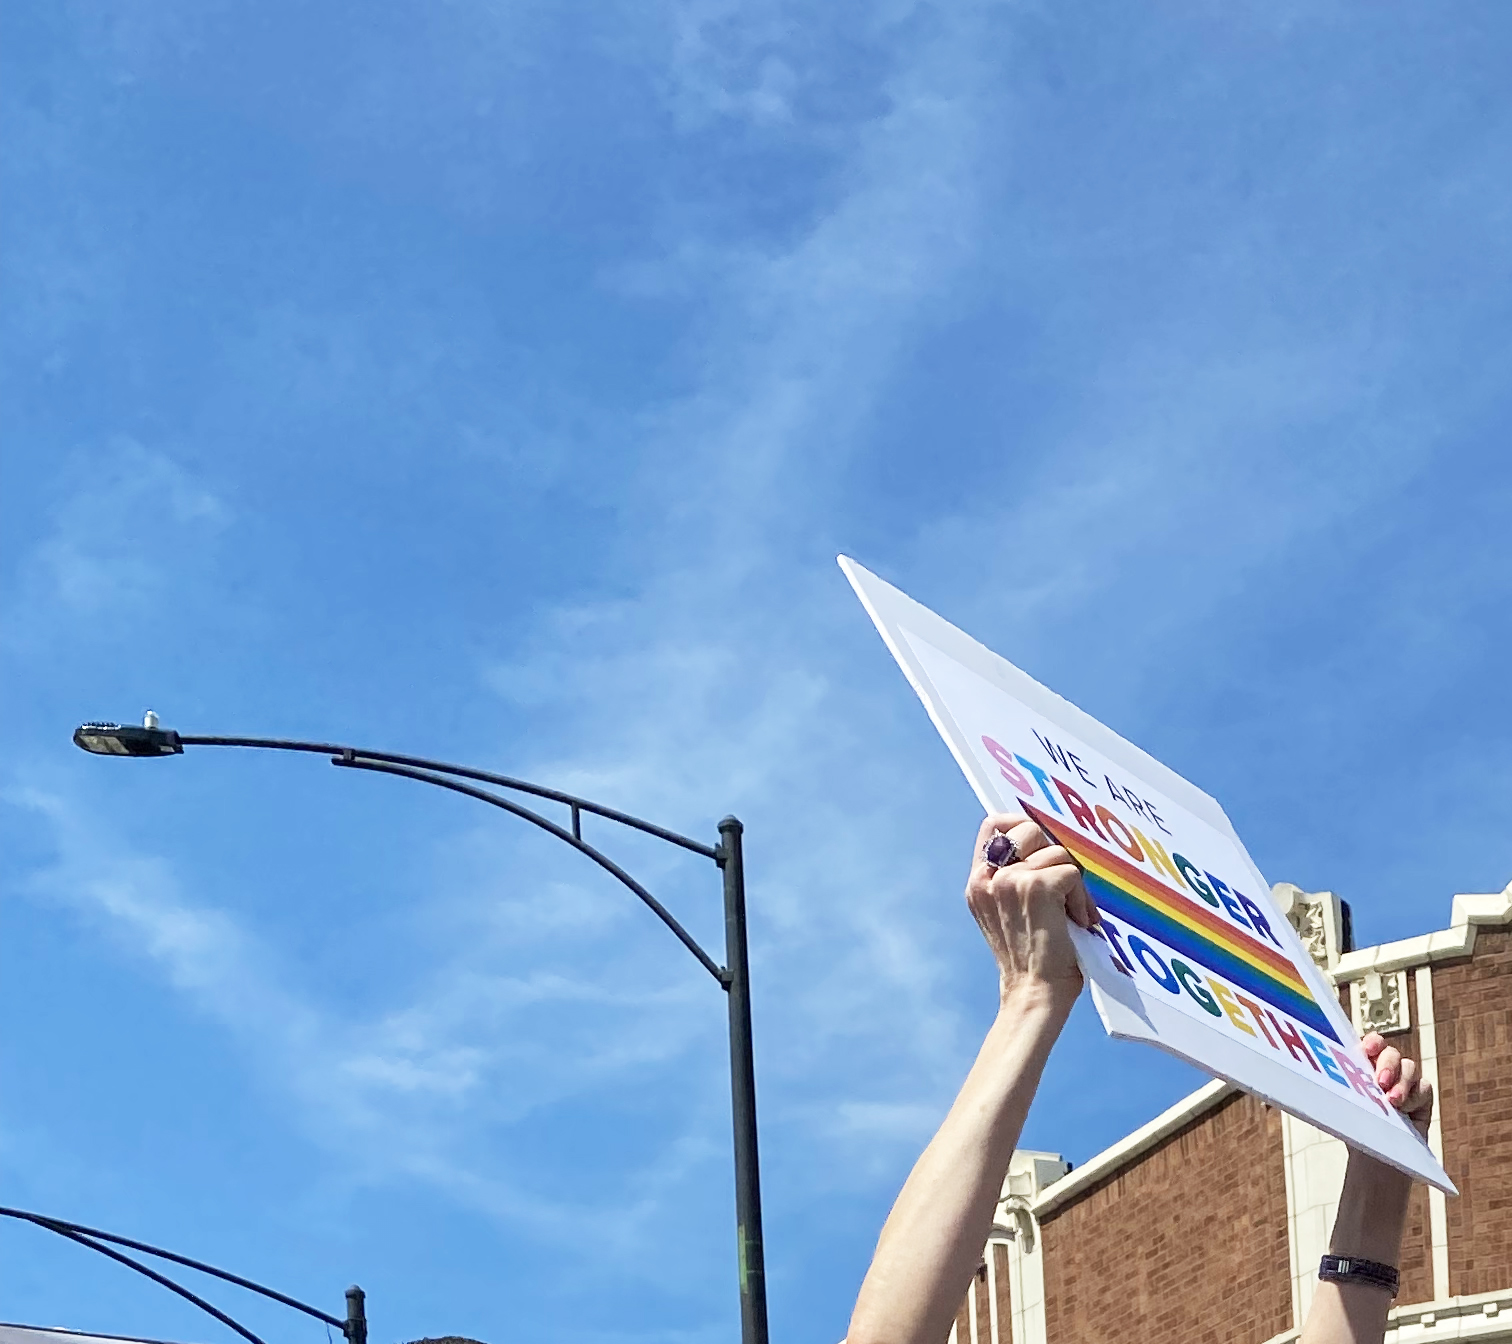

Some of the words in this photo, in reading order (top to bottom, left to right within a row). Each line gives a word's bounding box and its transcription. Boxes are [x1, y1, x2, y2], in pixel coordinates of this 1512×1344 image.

[981, 735, 1285, 951] STRONGER
[1031, 728, 1097, 789] WE
[1104, 774, 1172, 836] ARE
[1099, 916, 1390, 1118] TOGETHER
